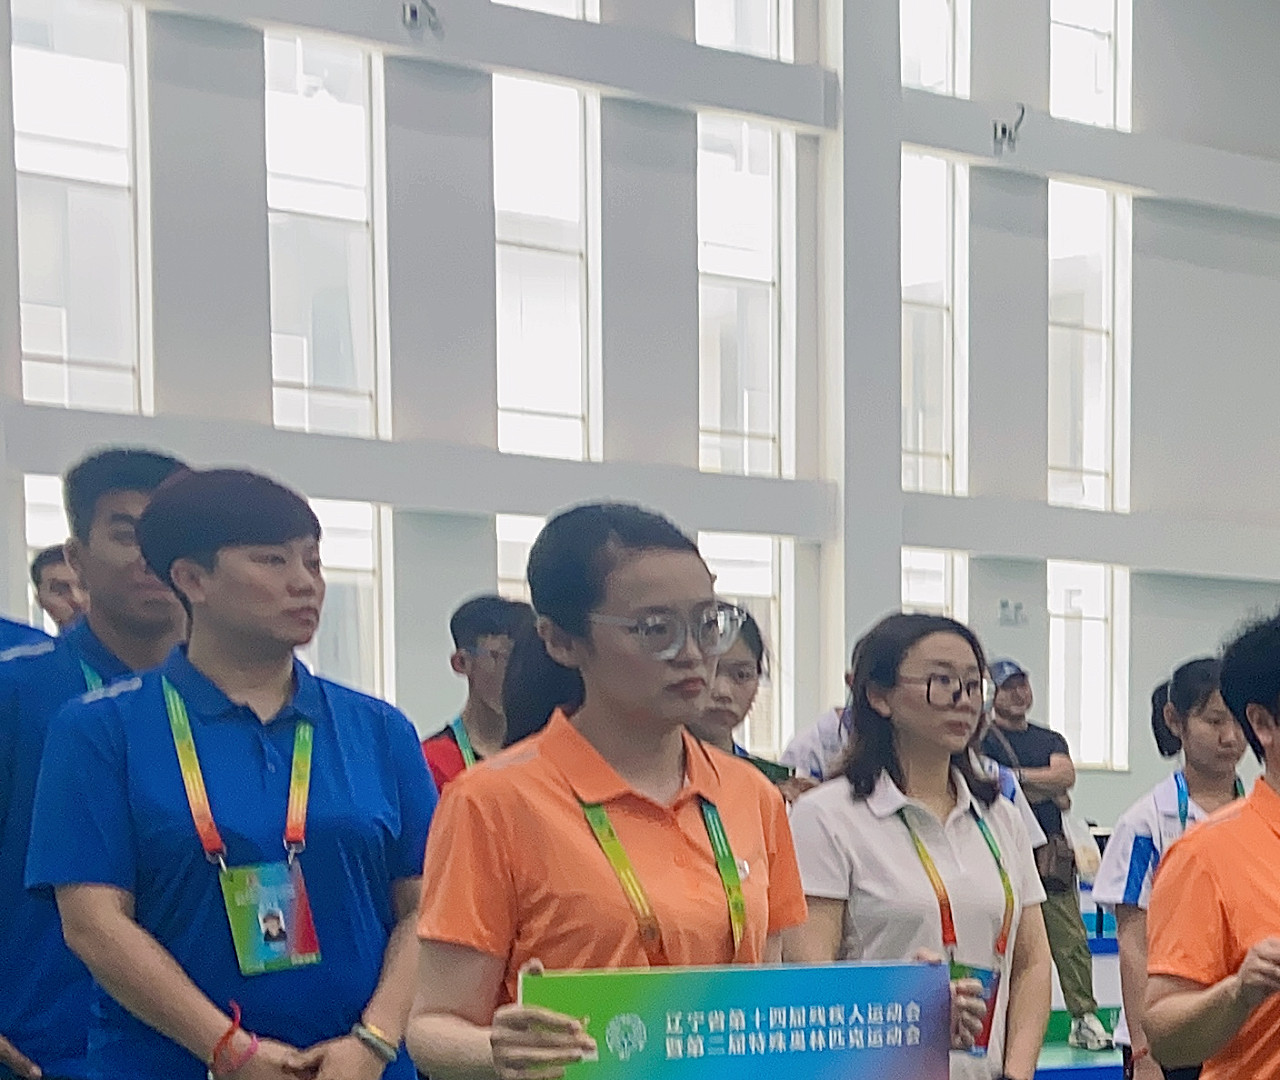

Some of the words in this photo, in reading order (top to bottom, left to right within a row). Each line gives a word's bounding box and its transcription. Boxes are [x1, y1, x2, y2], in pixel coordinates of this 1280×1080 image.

[664, 1000, 922, 1035] 辽宁省第十四届残疾人运动会
[664, 1023, 922, 1061] 暨第二届特殊奥林匹克运动会
